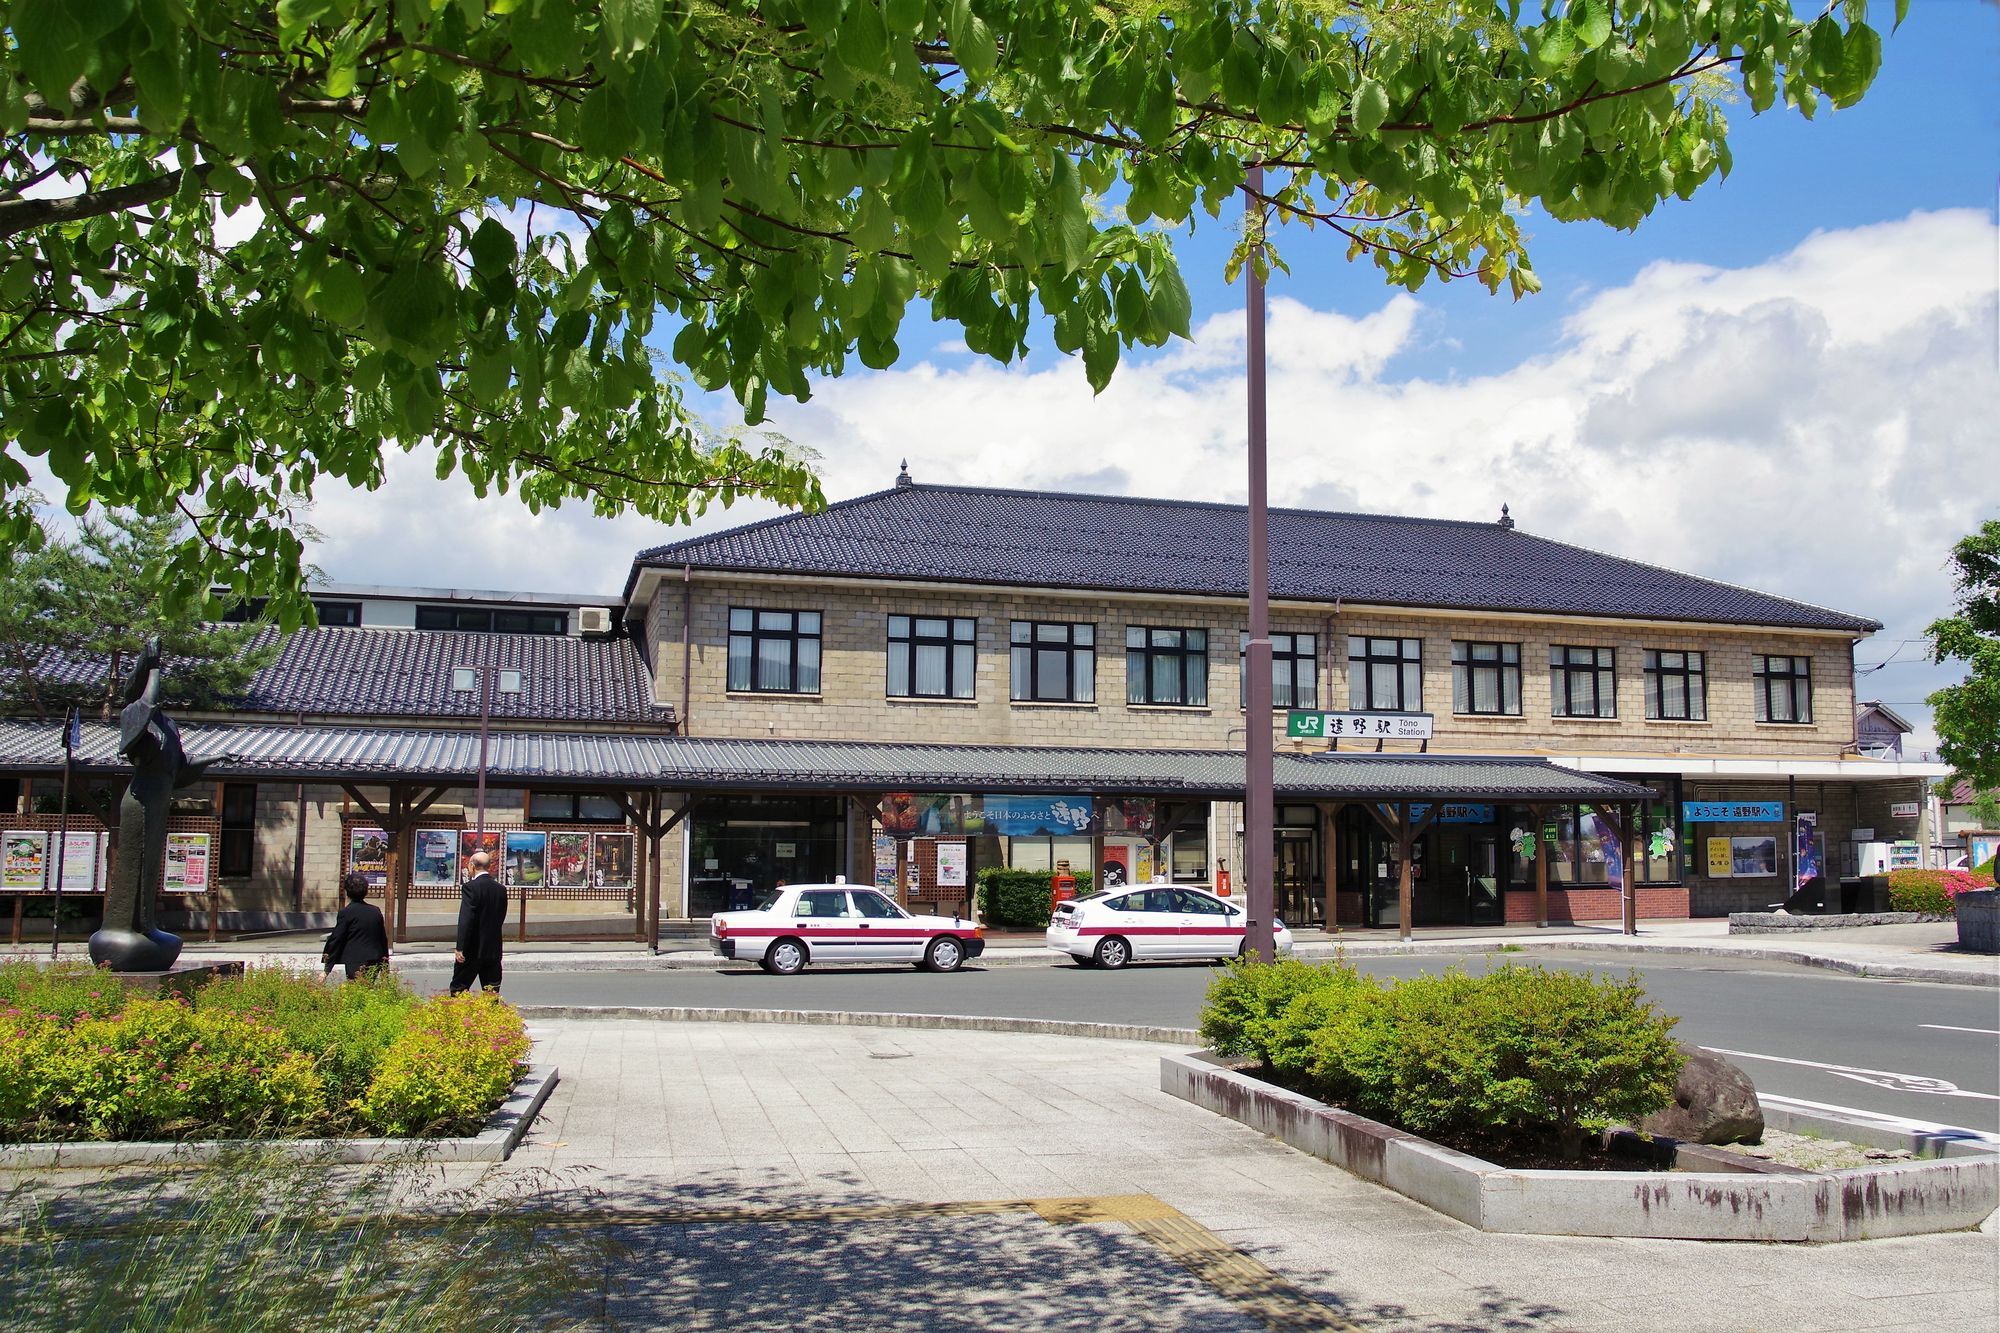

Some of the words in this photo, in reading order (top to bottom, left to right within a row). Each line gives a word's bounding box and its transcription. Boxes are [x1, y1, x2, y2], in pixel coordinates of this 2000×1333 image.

[1297, 716, 1319, 730] JR
[1330, 717, 1391, 734] 遠野駅
[1398, 728, 1425, 736] Station
[1694, 806, 1729, 817] ようこそ
[1733, 806, 1770, 818] 遠野駅へ
